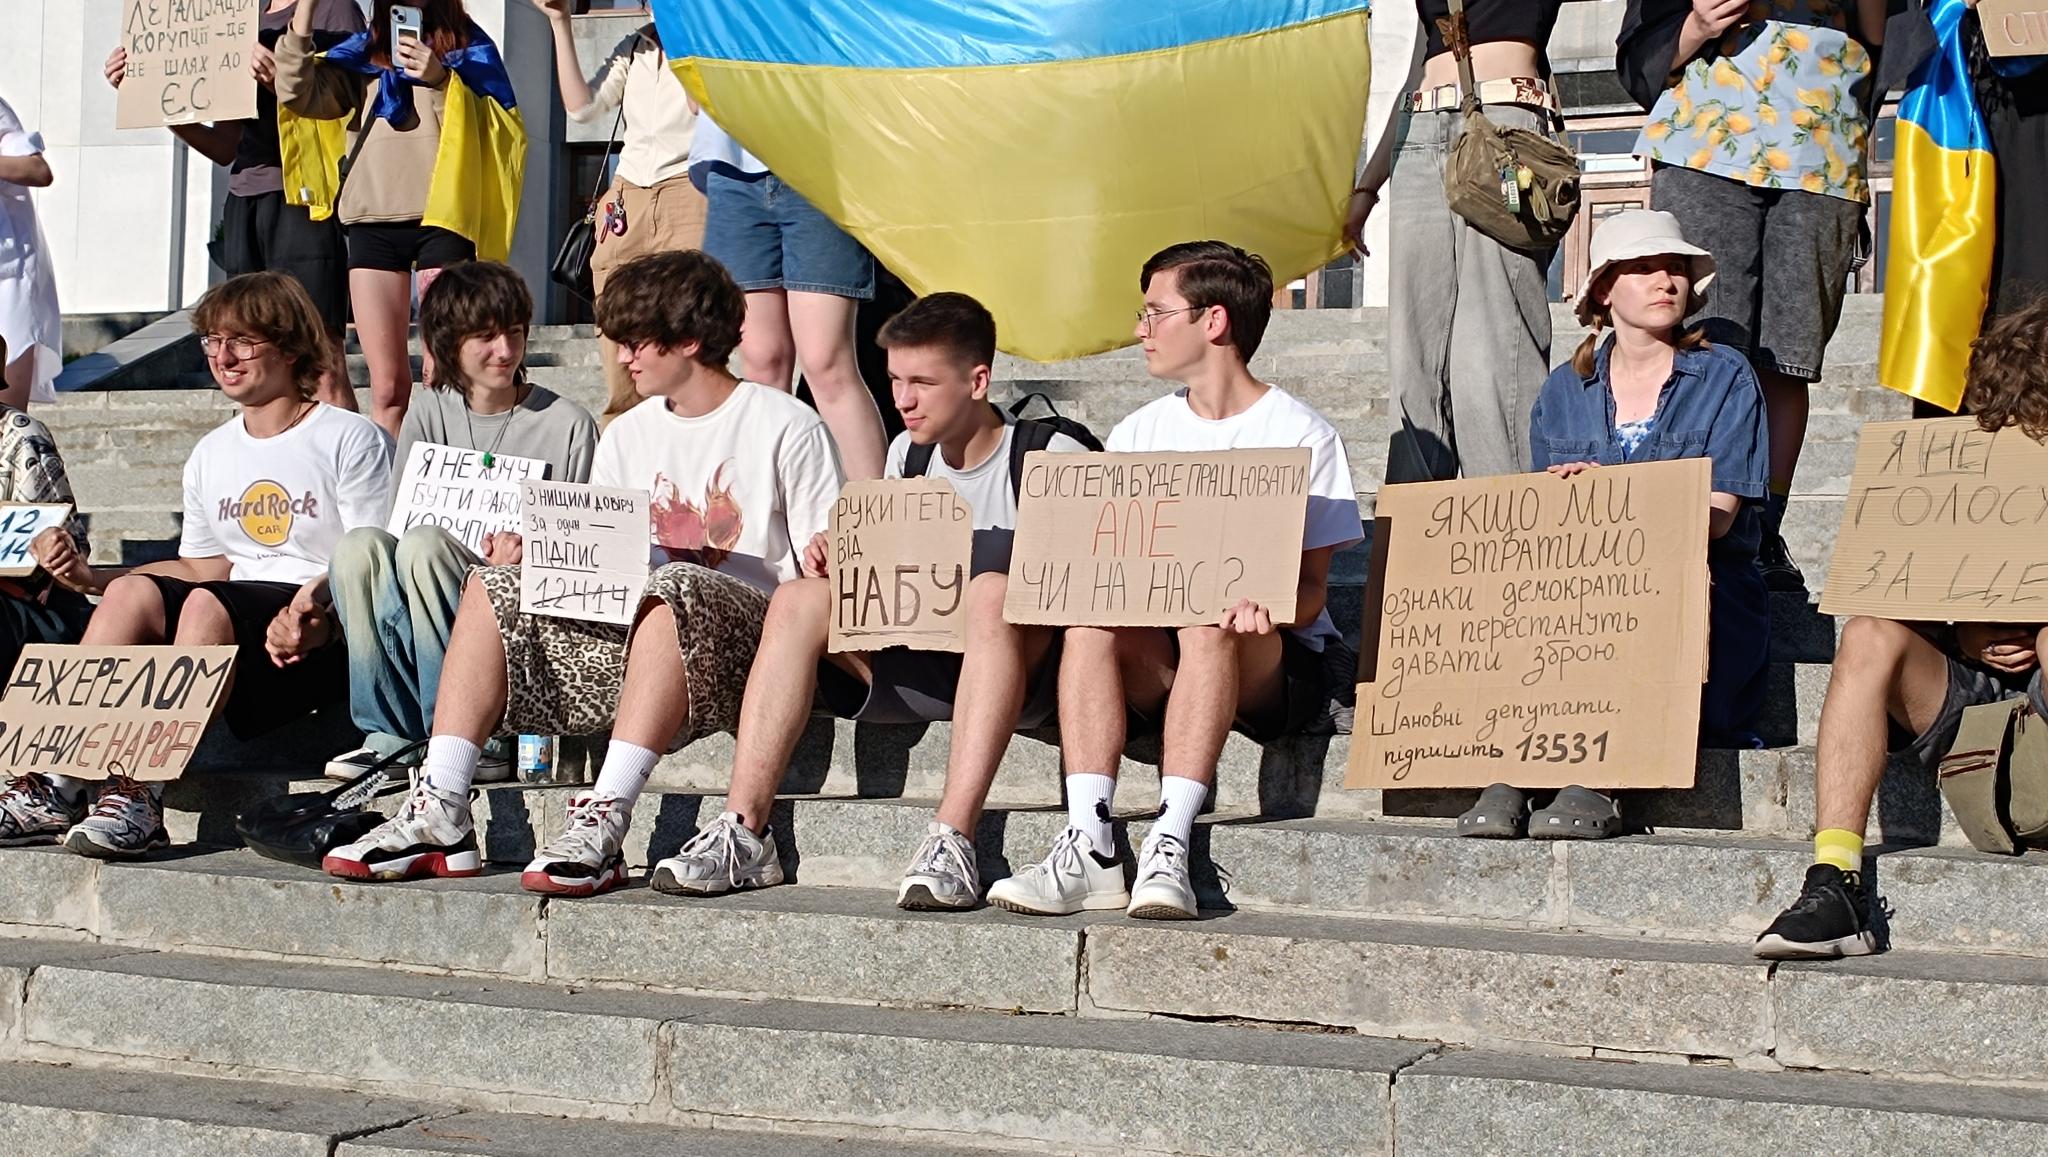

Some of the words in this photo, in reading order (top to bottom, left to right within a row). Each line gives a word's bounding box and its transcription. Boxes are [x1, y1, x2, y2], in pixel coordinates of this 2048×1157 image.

[125, 62, 145, 78] НЕ
[164, 56, 209, 77] ШЛЯХ
[219, 52, 241, 73] ДО
[161, 77, 211, 116] ЄС
[417, 448, 436, 479] Я
[439, 451, 476, 481] НЕ
[1880, 430, 1908, 475] Я
[1924, 430, 1984, 475] НЕ
[411, 482, 475, 512] БУТИ
[478, 488, 523, 515] РАБО
[1026, 463, 1124, 498] СИСТЕМА
[1129, 463, 1184, 498] БУДЕ
[1186, 463, 1305, 501] ПРАЦЮВАТИ
[0, 509, 40, 534] 12
[218, 493, 265, 521] Hard
[267, 490, 319, 520] Rock
[836, 492, 894, 532] РУКИ
[904, 491, 967, 522] ГЕТЬ
[1424, 487, 1540, 545] ЯКЩО
[1558, 477, 1637, 528] МИ
[1092, 500, 1182, 558] АЛЕ
[0, 537, 30, 563] 14
[531, 536, 600, 568] ПІДПИС
[838, 562, 964, 629] НАБУ
[1022, 561, 1070, 613] ЧИ
[1091, 562, 1127, 614] НА
[1147, 561, 1206, 616] НАС
[1852, 551, 1914, 600] ЗА
[1939, 554, 2048, 609] ЦЕ
[1, 655, 232, 711] ДЖЕРЕЛОМ
[1371, 700, 1463, 736] Шановні
[0, 720, 87, 767] ЛАДИ
[1515, 729, 1609, 764] 13531
